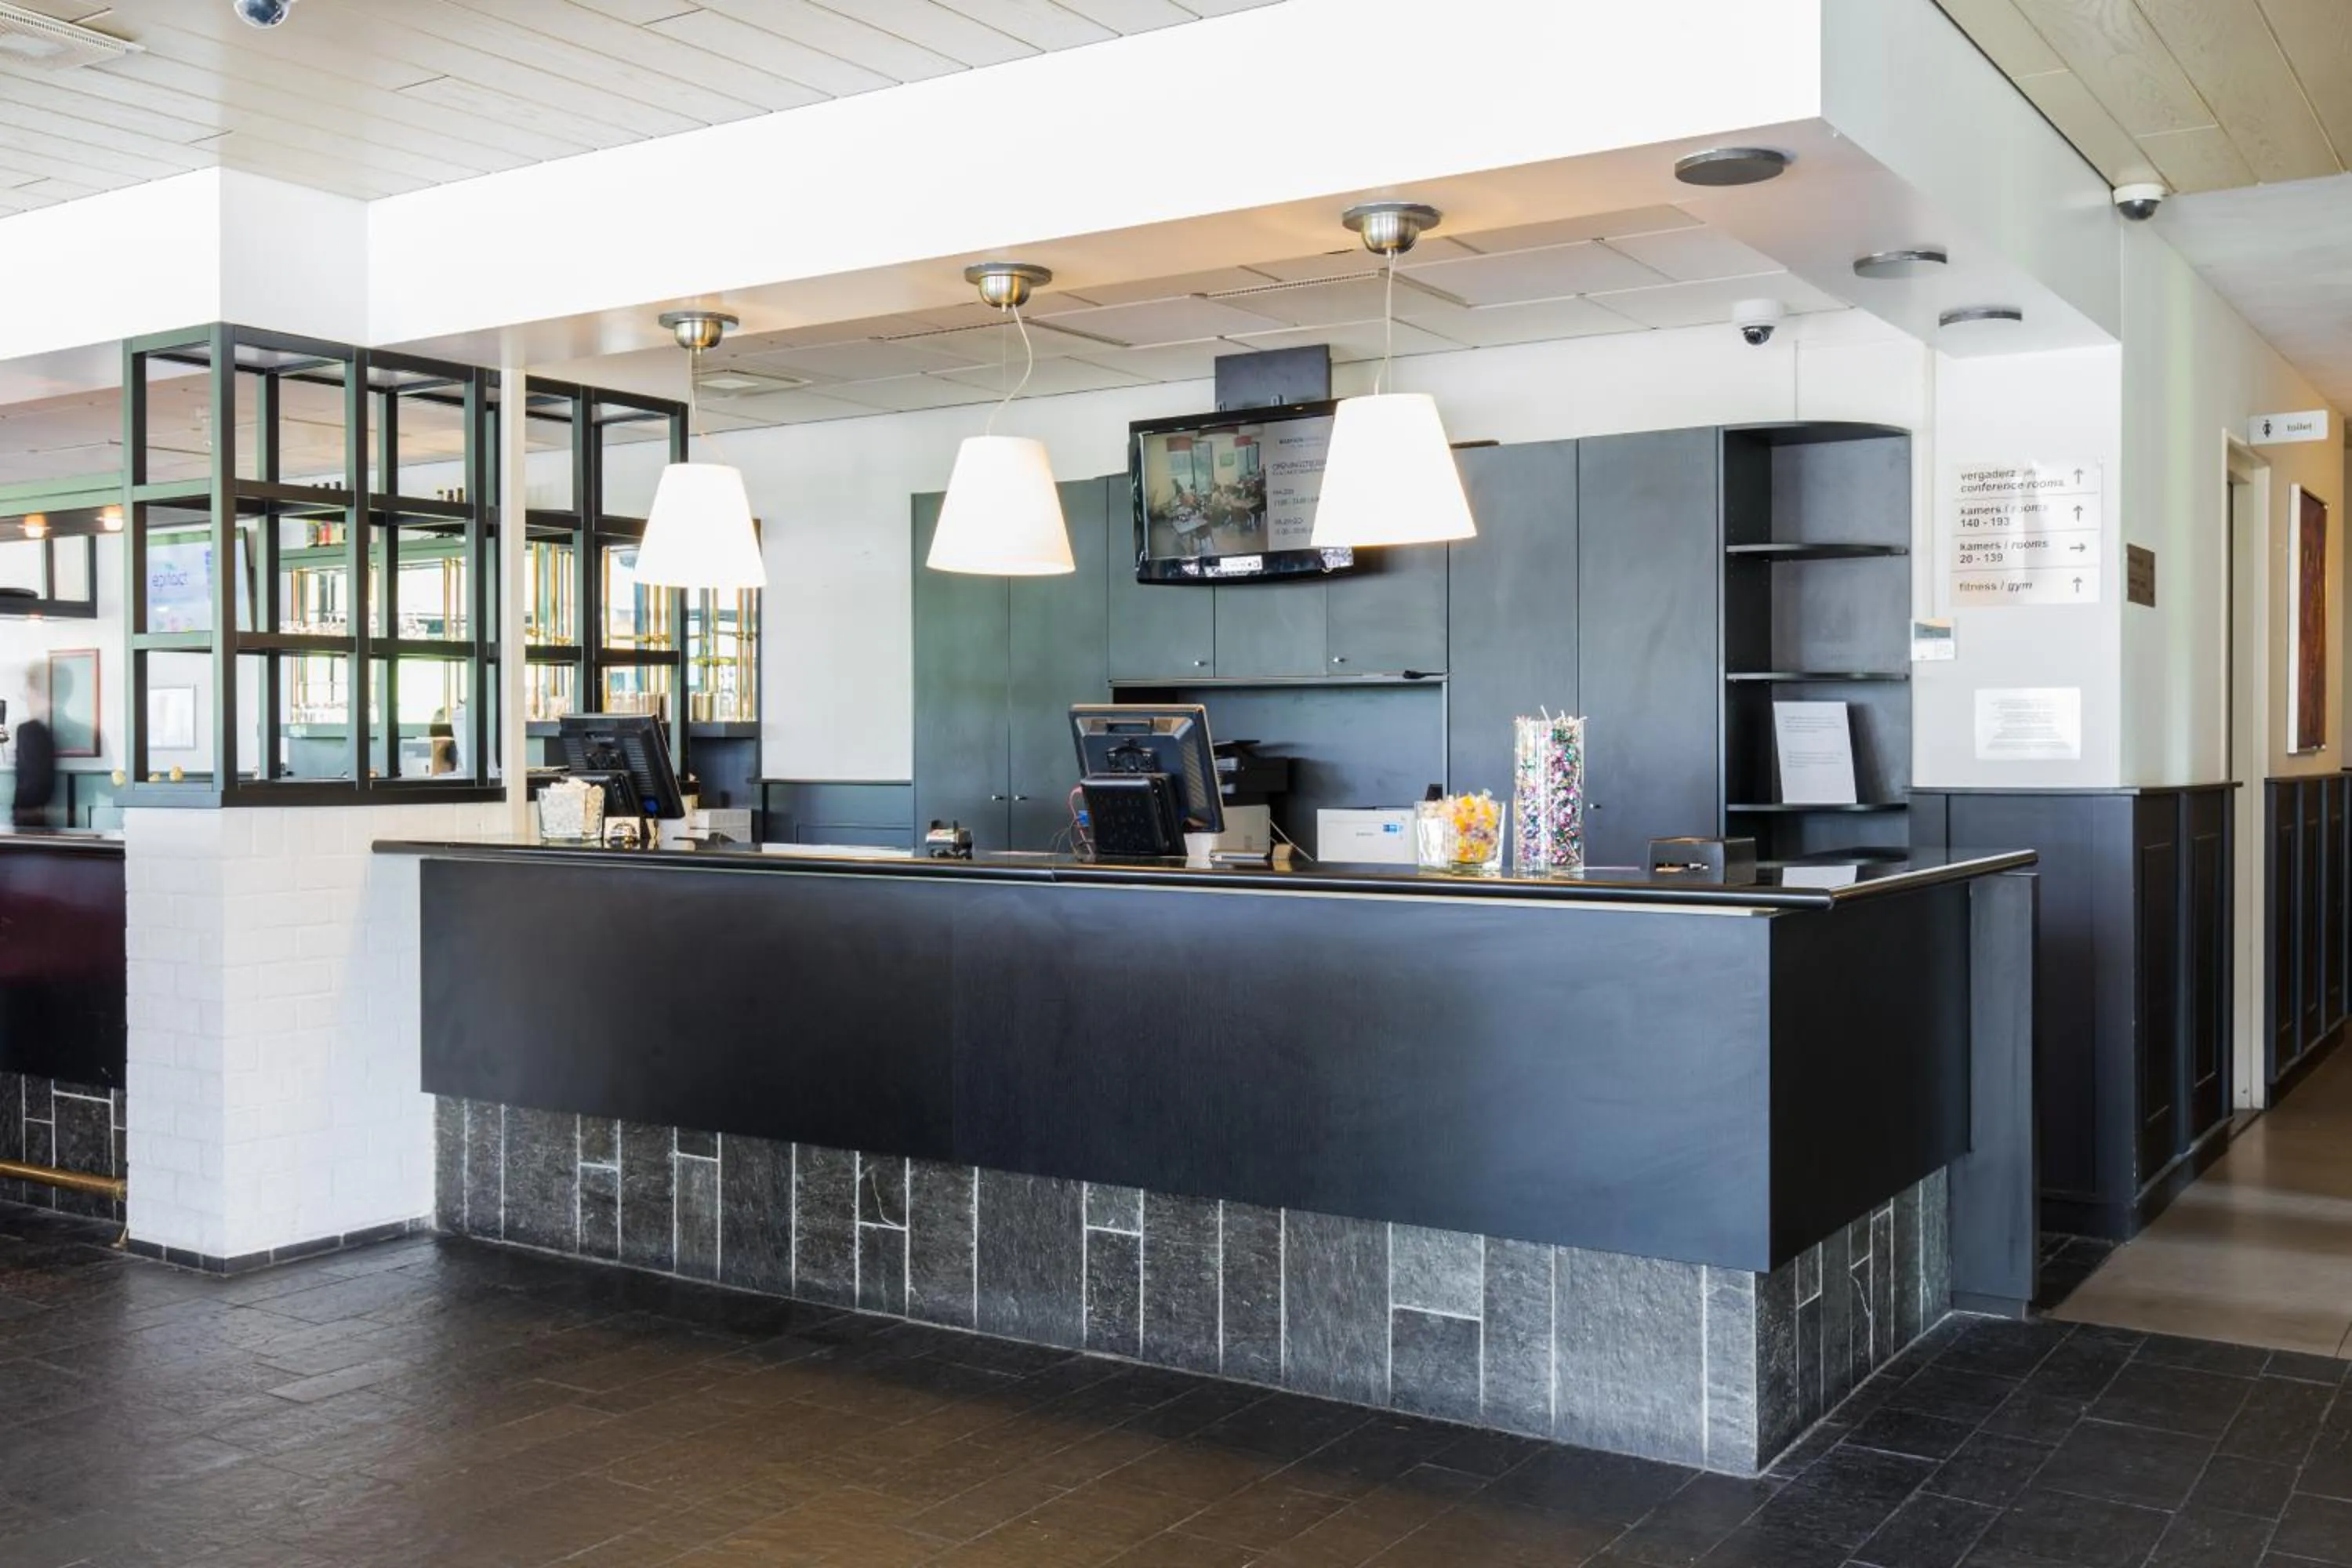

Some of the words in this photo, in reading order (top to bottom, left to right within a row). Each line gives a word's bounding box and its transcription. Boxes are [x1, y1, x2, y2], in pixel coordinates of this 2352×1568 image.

[2287, 423, 2312, 432] toilet
[1961, 482, 2024, 493] conference
[2027, 479, 2064, 489] rooms
[1960, 503, 2001, 515] kamers
[1961, 518, 1980, 528] 140
[1991, 517, 2010, 527] 193
[1960, 541, 2002, 551] kamers
[2011, 539, 2049, 550] rooms
[1960, 554, 1973, 564] 20
[1984, 553, 2003, 563] 139
[1959, 583, 1997, 592] fitness
[2007, 582, 2033, 592] gym
